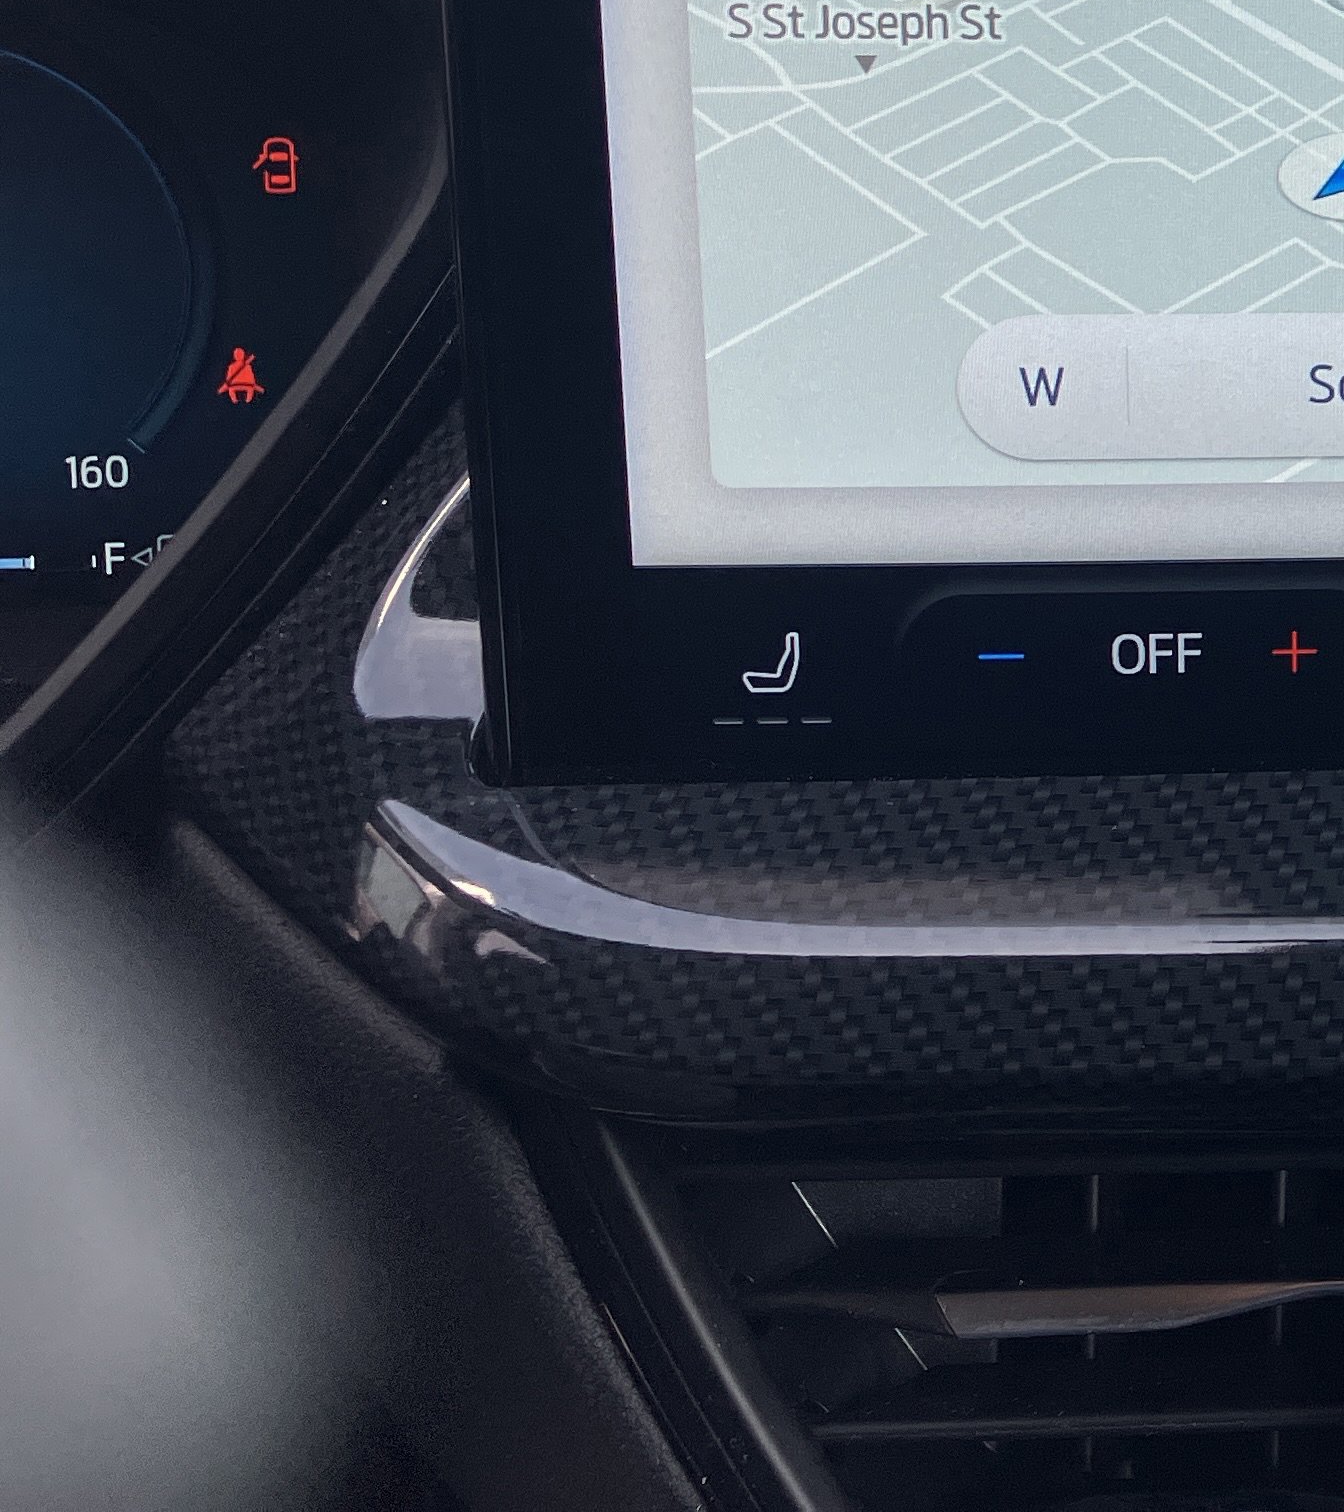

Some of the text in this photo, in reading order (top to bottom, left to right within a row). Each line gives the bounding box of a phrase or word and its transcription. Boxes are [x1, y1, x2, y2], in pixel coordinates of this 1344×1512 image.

[728, 3, 1002, 46] S St Joseph St
[1019, 367, 1065, 407] W
[65, 455, 129, 489] 160
[104, 542, 125, 575] F
[1111, 632, 1203, 675] OFF
